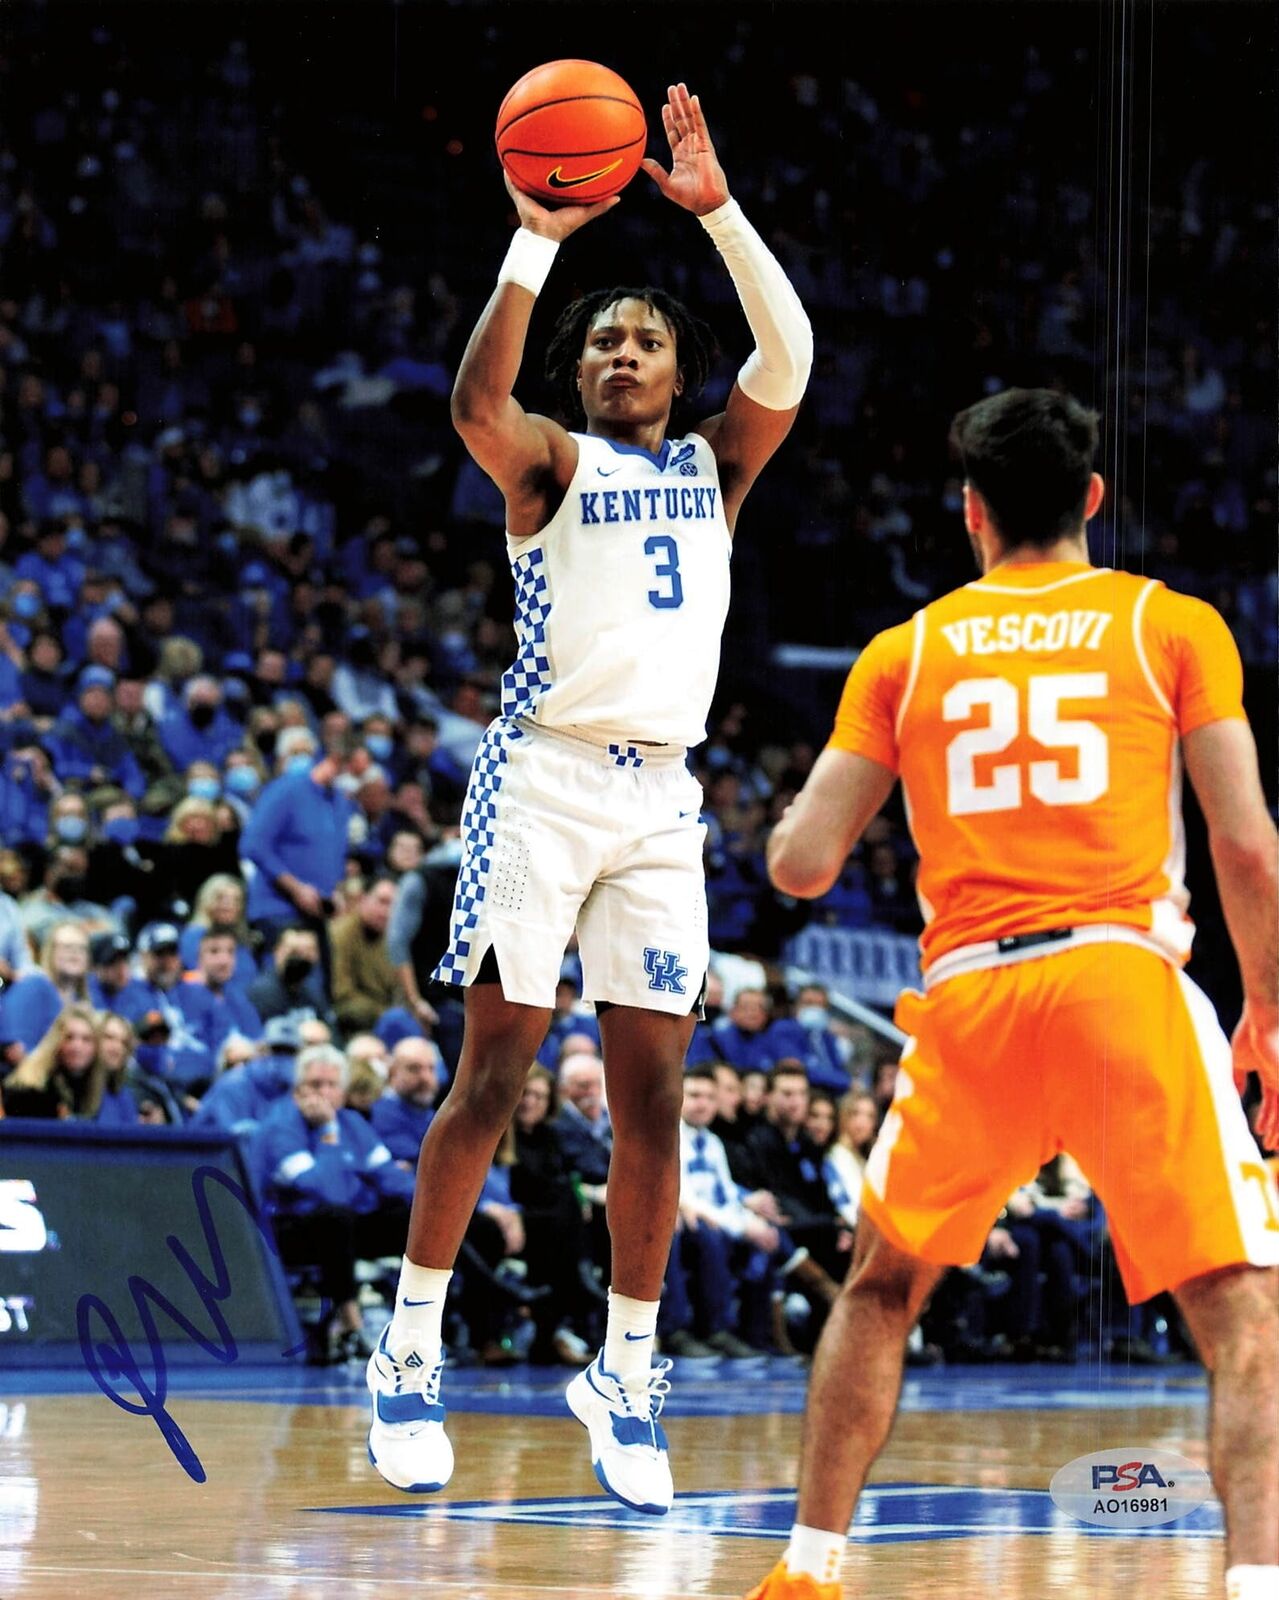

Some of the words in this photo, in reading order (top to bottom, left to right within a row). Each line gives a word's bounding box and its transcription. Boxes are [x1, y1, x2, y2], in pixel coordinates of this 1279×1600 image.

[580, 487, 717, 525] KENTUCKY
[643, 535, 684, 609] 3
[940, 609, 1113, 656] VESCOVI
[942, 671, 1109, 817] 25
[643, 947, 688, 995] UK
